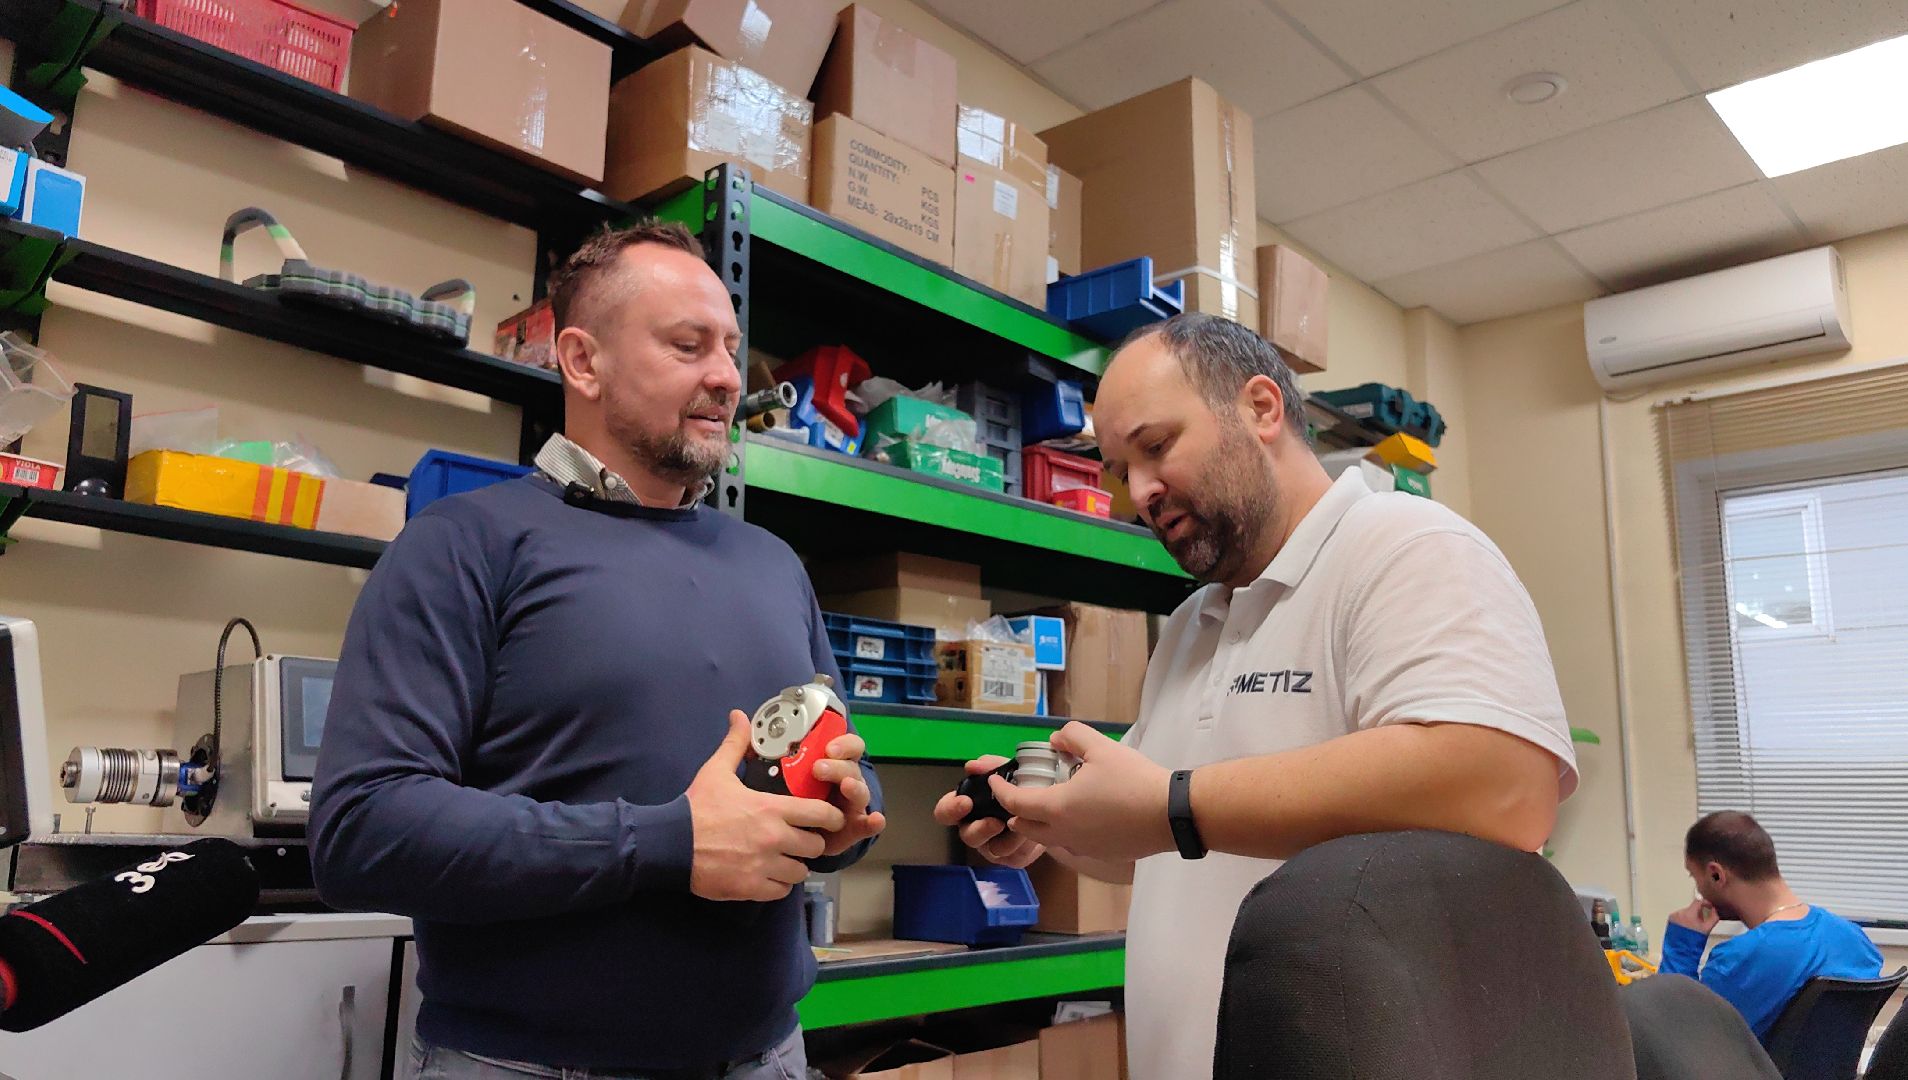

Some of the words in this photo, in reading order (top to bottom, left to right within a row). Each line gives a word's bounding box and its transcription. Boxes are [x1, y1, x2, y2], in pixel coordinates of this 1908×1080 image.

[849, 139, 910, 175] COMMODITY:
[848, 153, 900, 184] QUANTITY:
[921, 186, 940, 203] PCS
[921, 200, 940, 217] KGS
[921, 214, 940, 230] KGS
[16, 460, 41, 470] VIOLA
[1236, 670, 1313, 694] METIZ
